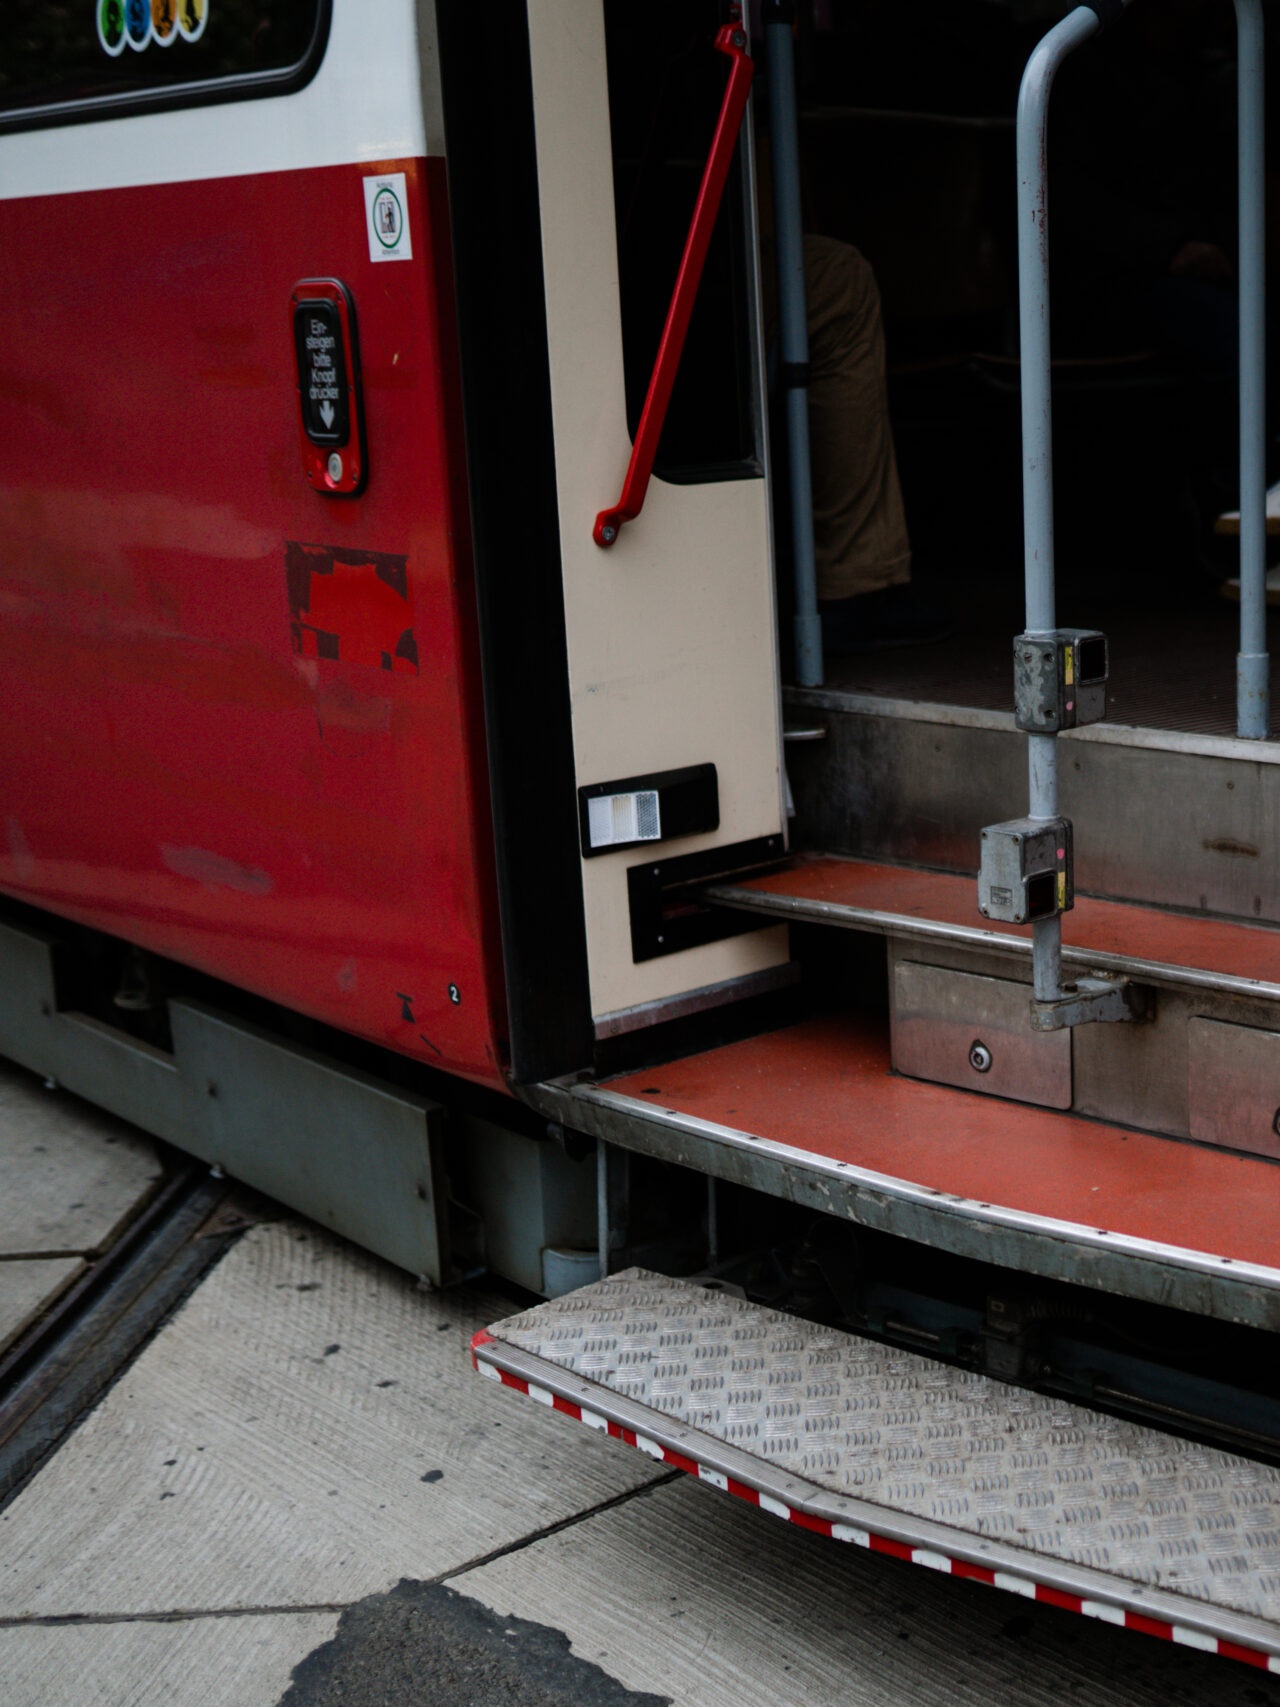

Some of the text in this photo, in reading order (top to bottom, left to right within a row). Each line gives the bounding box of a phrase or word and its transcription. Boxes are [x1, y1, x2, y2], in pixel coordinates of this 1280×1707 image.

[306, 336, 335, 353] steigen
[313, 352, 331, 367] bitte
[311, 368, 336, 385] Knopf
